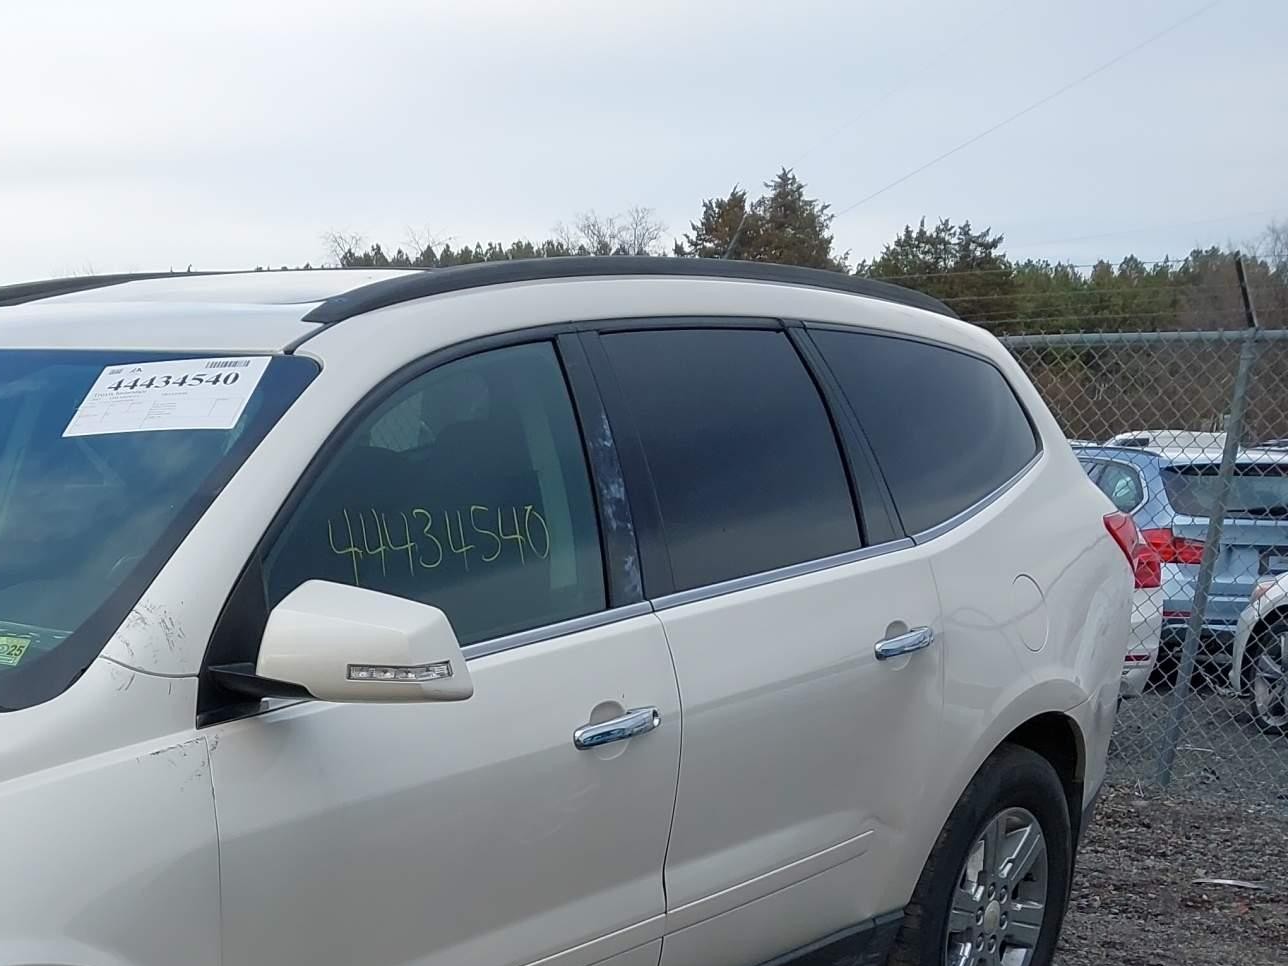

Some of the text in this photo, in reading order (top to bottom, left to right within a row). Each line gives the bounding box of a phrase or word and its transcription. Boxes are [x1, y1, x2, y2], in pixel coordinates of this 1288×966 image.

[106, 371, 240, 392] 44434540
[327, 504, 550, 585] 44434540
[6, 643, 25, 657] 25
